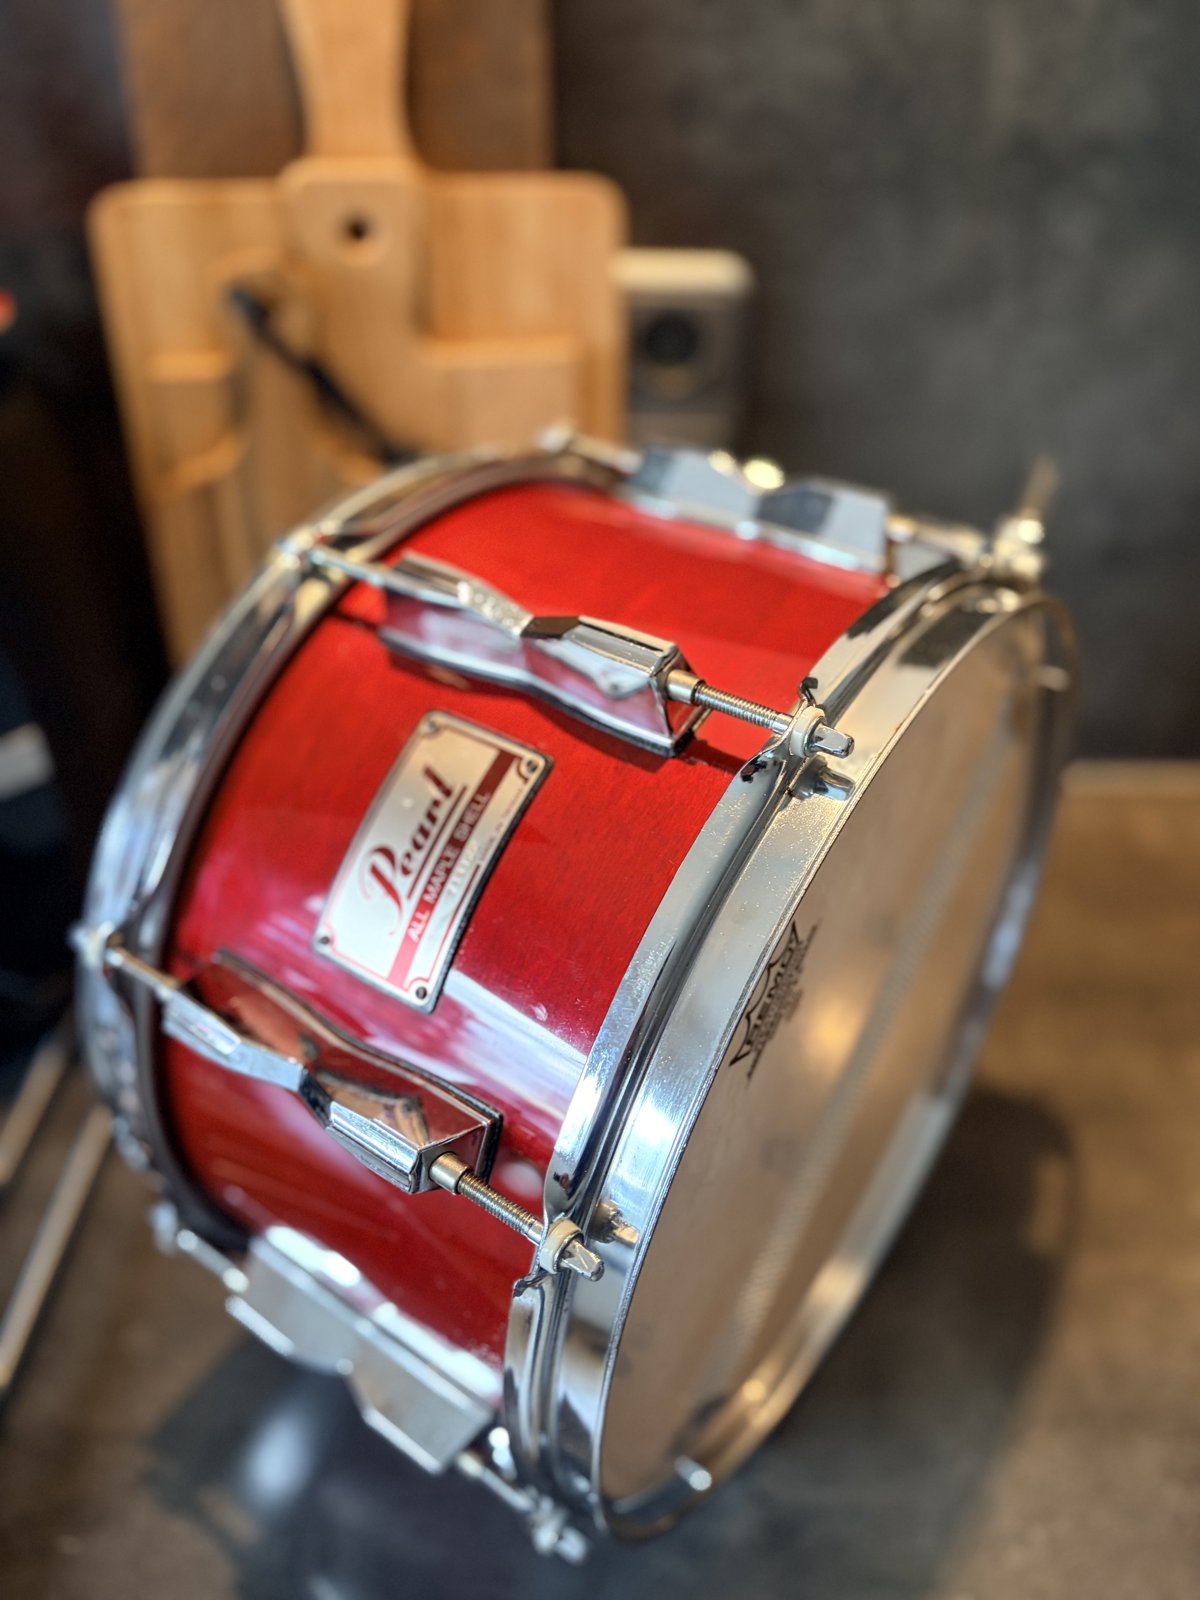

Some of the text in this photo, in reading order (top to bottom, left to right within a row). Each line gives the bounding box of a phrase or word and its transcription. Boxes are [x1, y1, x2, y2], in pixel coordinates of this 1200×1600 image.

[357, 765, 453, 934] Pearl
[407, 909, 431, 942] ALL
[423, 843, 461, 905] MAPLE
[453, 791, 491, 843] SHELL
